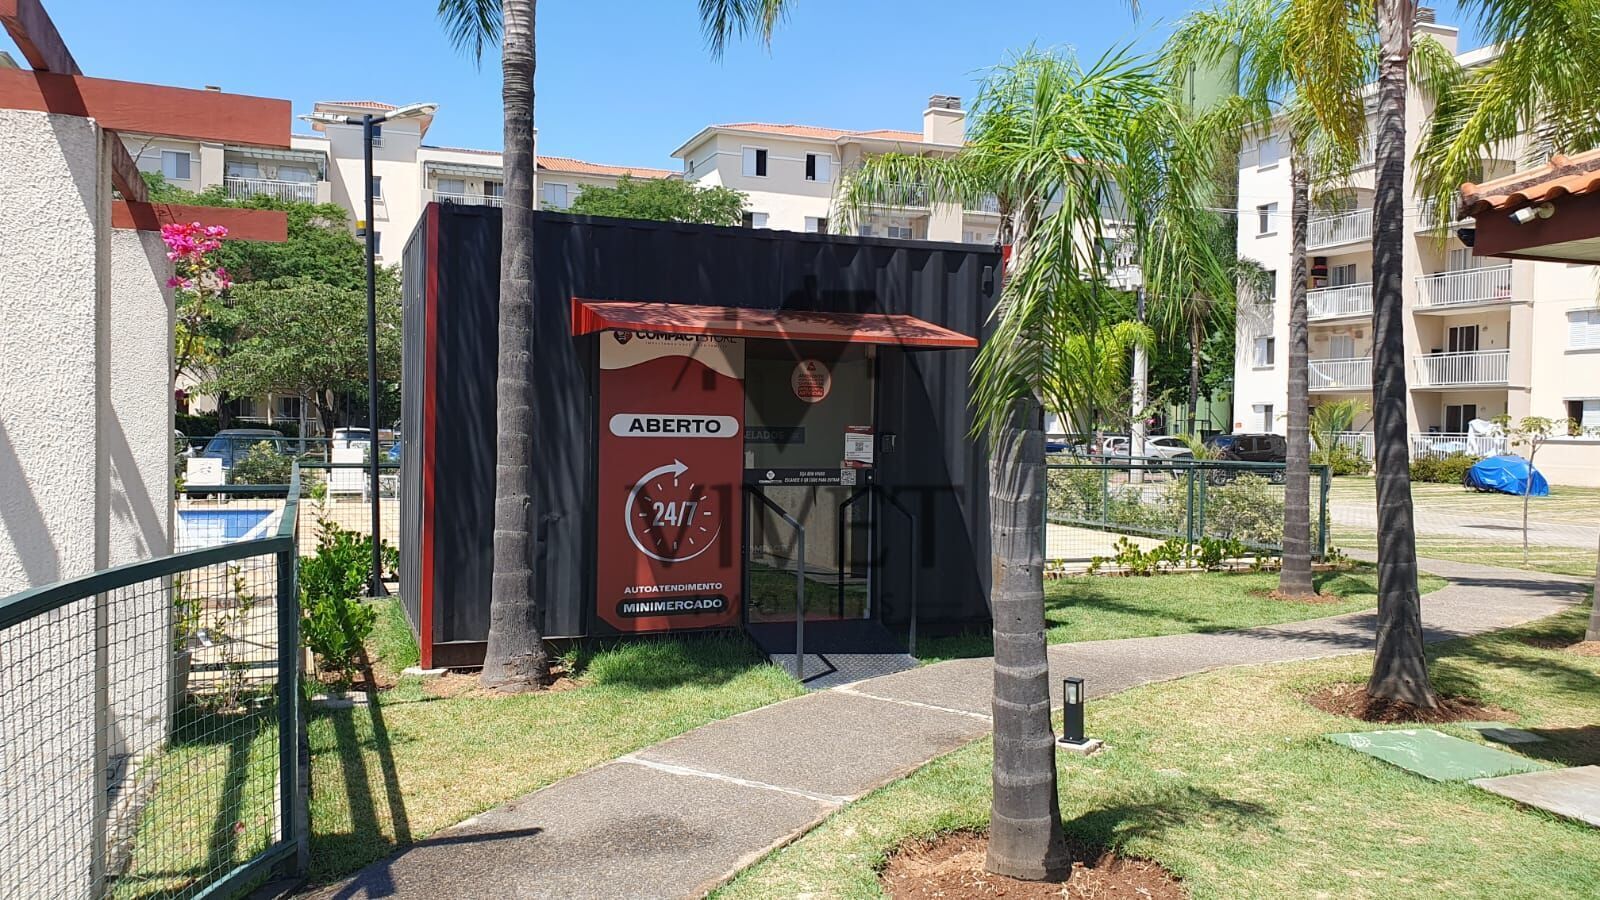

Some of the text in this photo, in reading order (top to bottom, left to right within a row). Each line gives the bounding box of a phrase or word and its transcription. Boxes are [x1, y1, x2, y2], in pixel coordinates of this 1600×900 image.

[629, 418, 721, 433] ABERTO
[653, 501, 698, 527] 24/7
[624, 582, 723, 594] AUTOATENDIMENTO
[623, 599, 723, 613] MINIMERCADO
